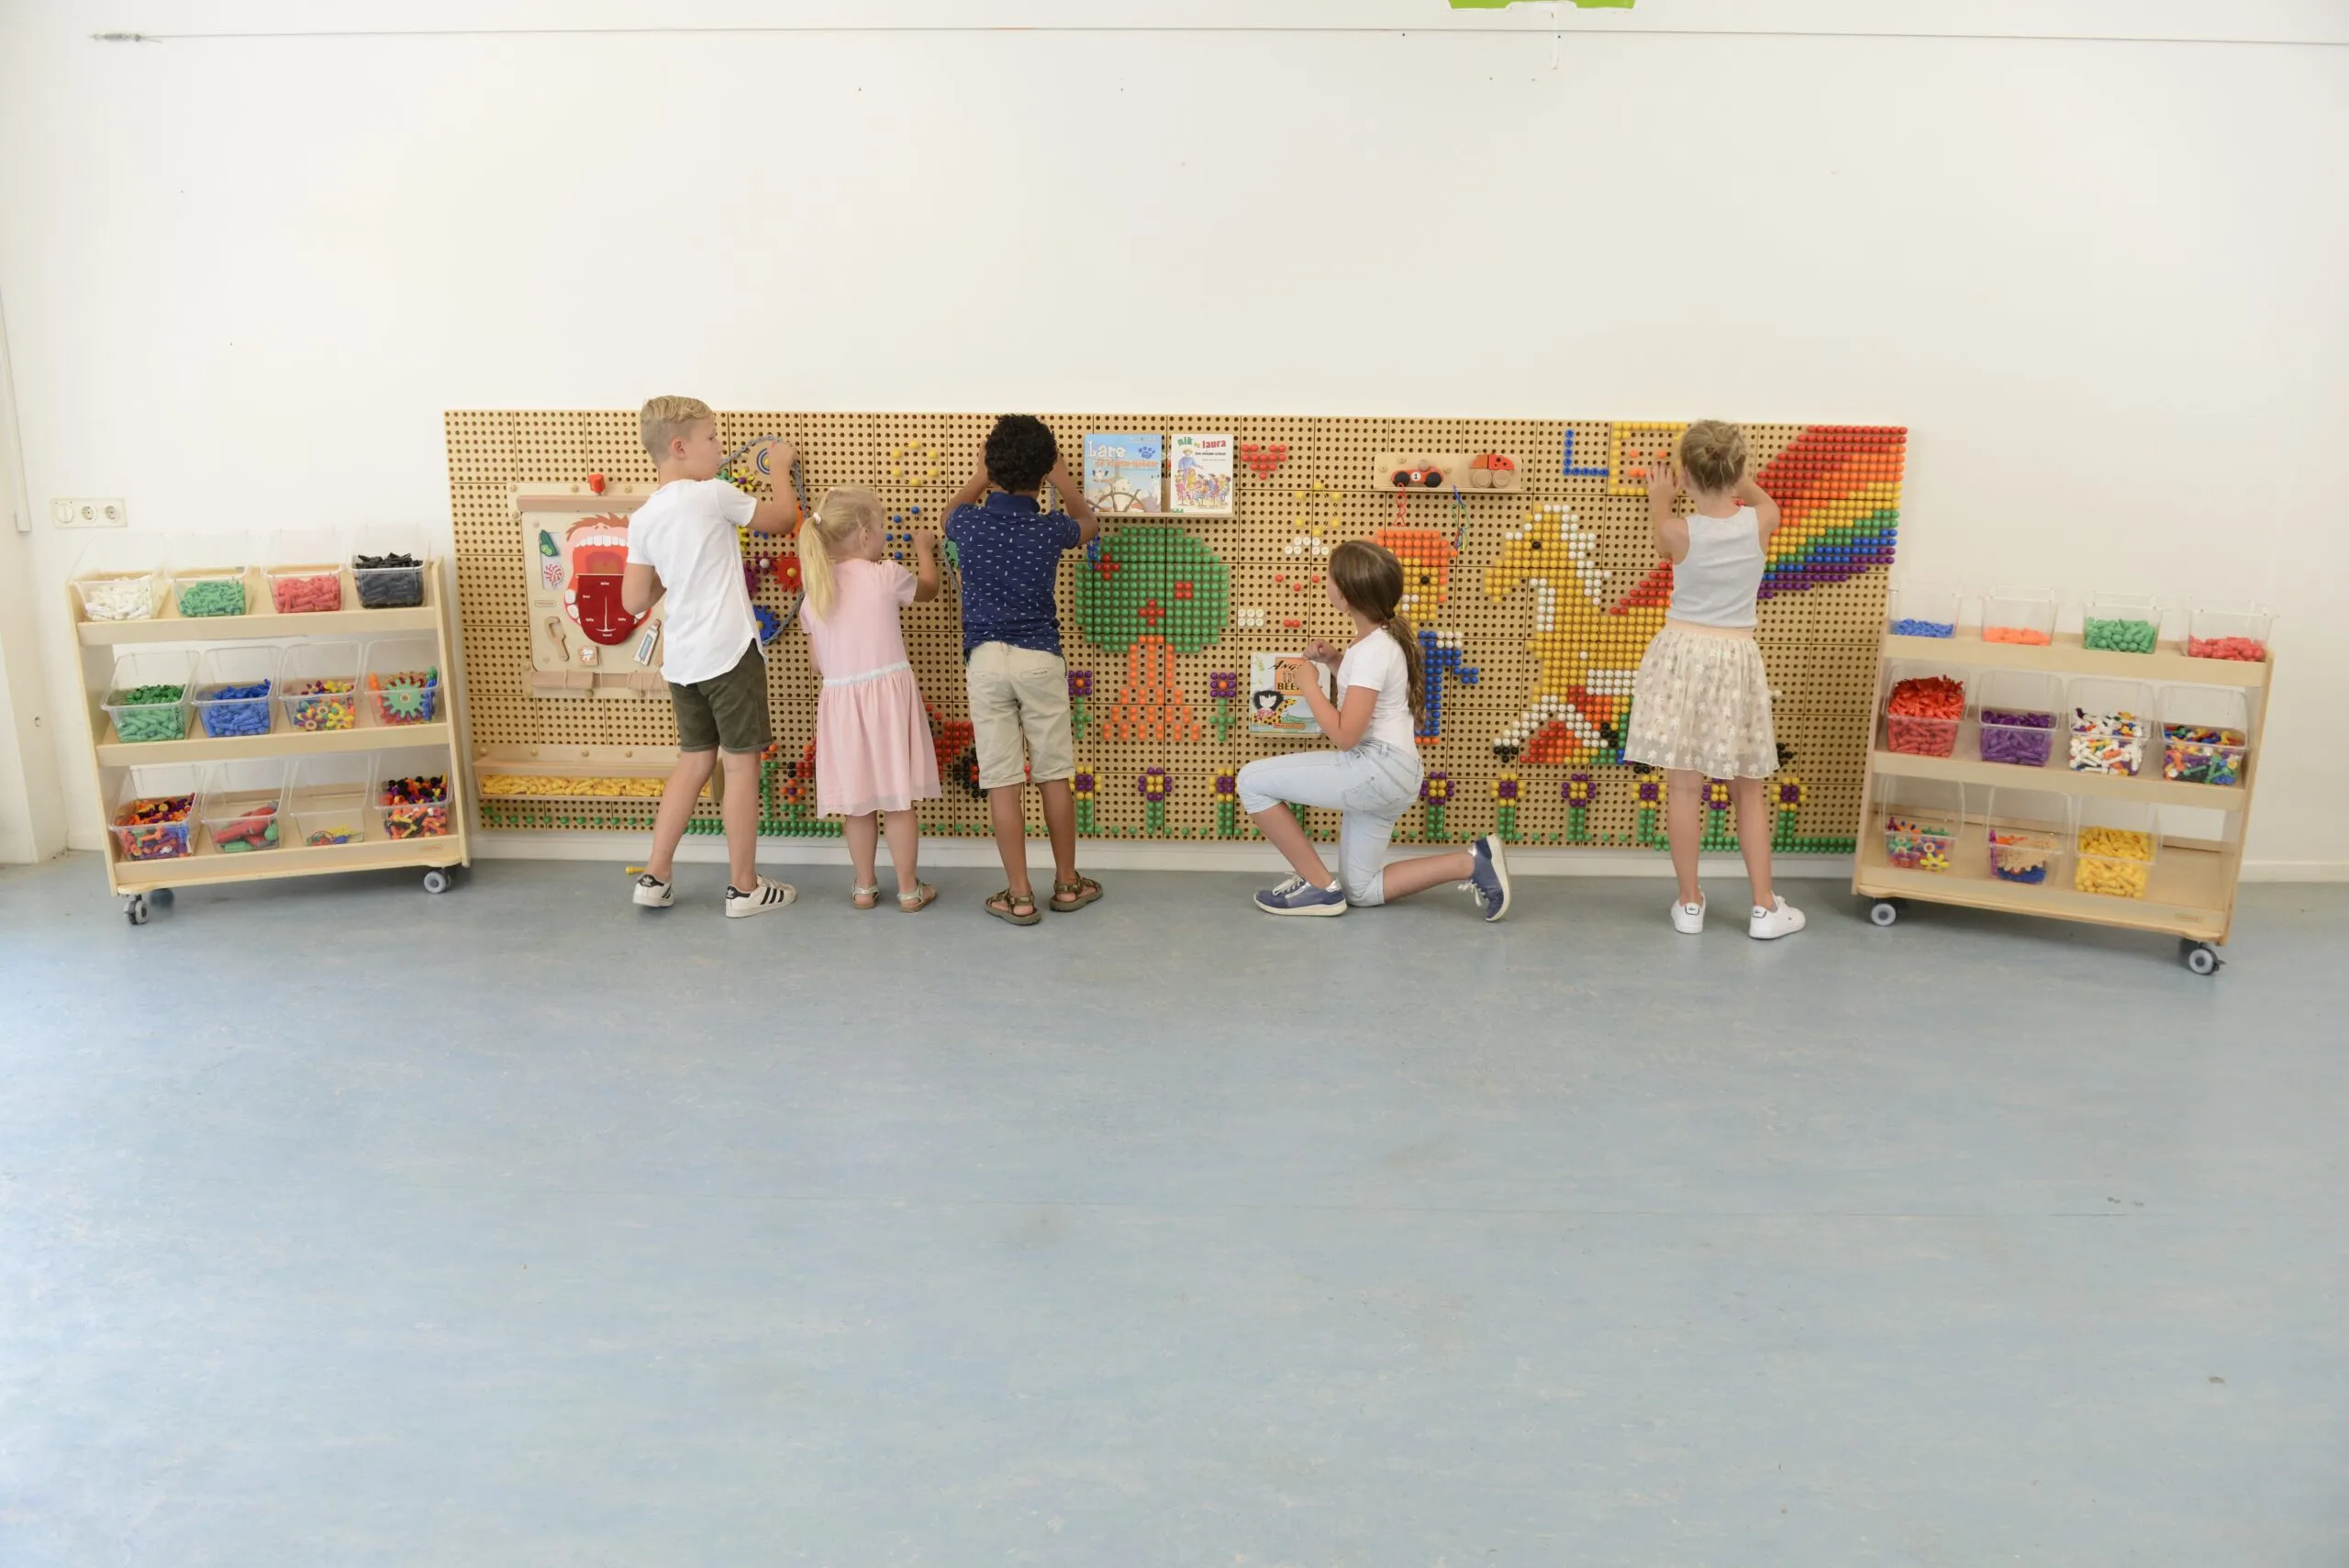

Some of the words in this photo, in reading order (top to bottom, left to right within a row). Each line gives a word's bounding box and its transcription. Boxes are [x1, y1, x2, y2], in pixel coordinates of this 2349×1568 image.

[1088, 440, 1126, 458] Lars
[1177, 436, 1193, 447] nik
[1202, 439, 1227, 449] laura
